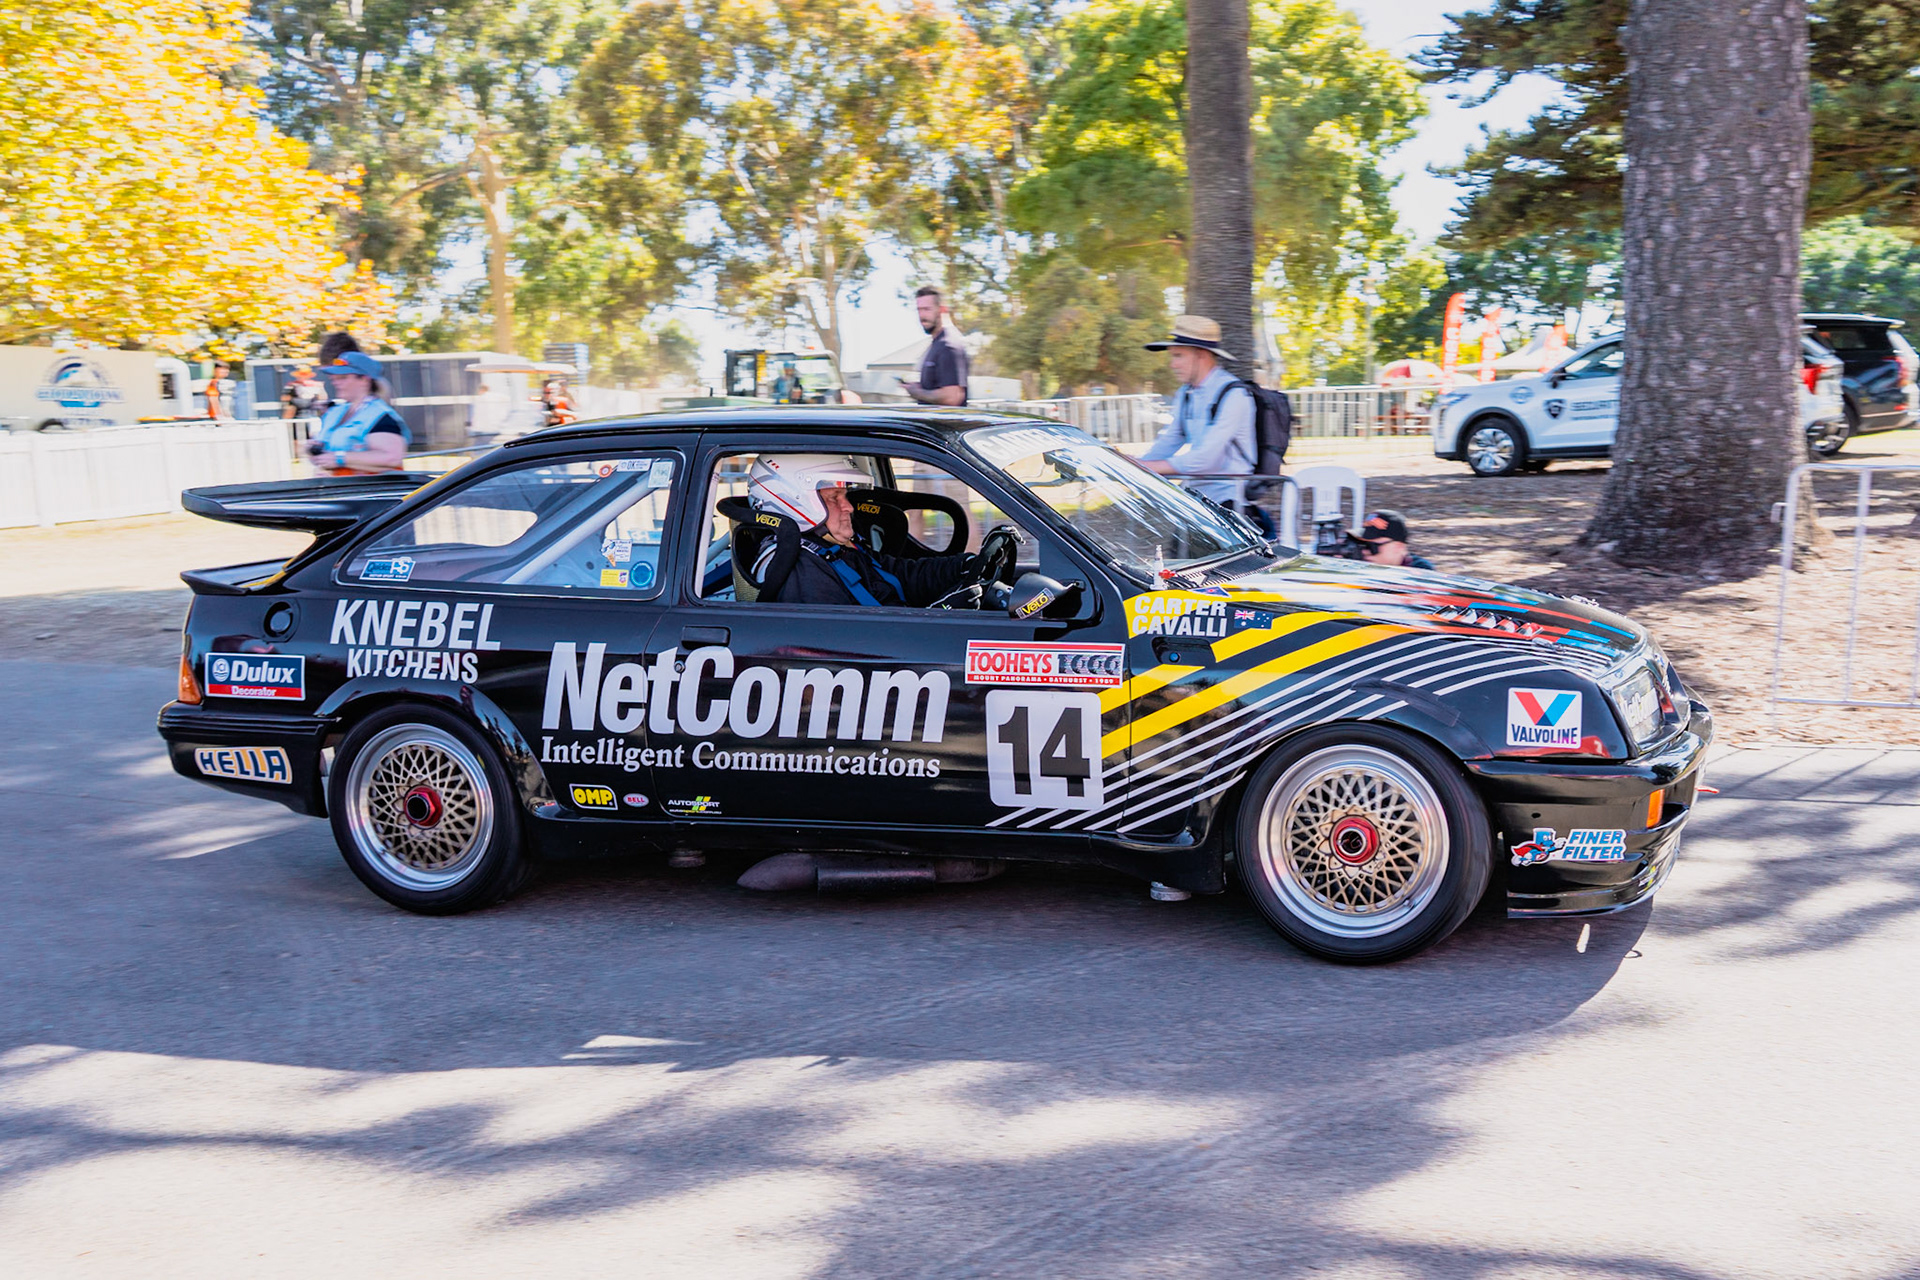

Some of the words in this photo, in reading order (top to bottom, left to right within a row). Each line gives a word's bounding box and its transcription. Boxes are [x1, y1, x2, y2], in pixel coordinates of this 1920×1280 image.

[1134, 596, 1227, 617] CARTER
[329, 599, 501, 651] KNEBEL
[1132, 615, 1228, 637] CAVALLI
[230, 660, 296, 684] Dulux
[346, 648, 479, 684] KITCHENS
[968, 652, 1052, 674] TOOHEYS
[1001, 675, 1042, 683] PANORAMA
[231, 685, 277, 697] Decorator
[541, 641, 952, 743] NetComm
[1511, 724, 1577, 745] VALVOLINE
[541, 736, 684, 772] Intelligent
[692, 741, 941, 778] Communications
[998, 706, 1091, 797] 14
[199, 749, 287, 780] HELLA
[667, 799, 720, 808] AUTOSPORT
[1568, 830, 1623, 845] FINER
[1561, 845, 1623, 860] FILTER
